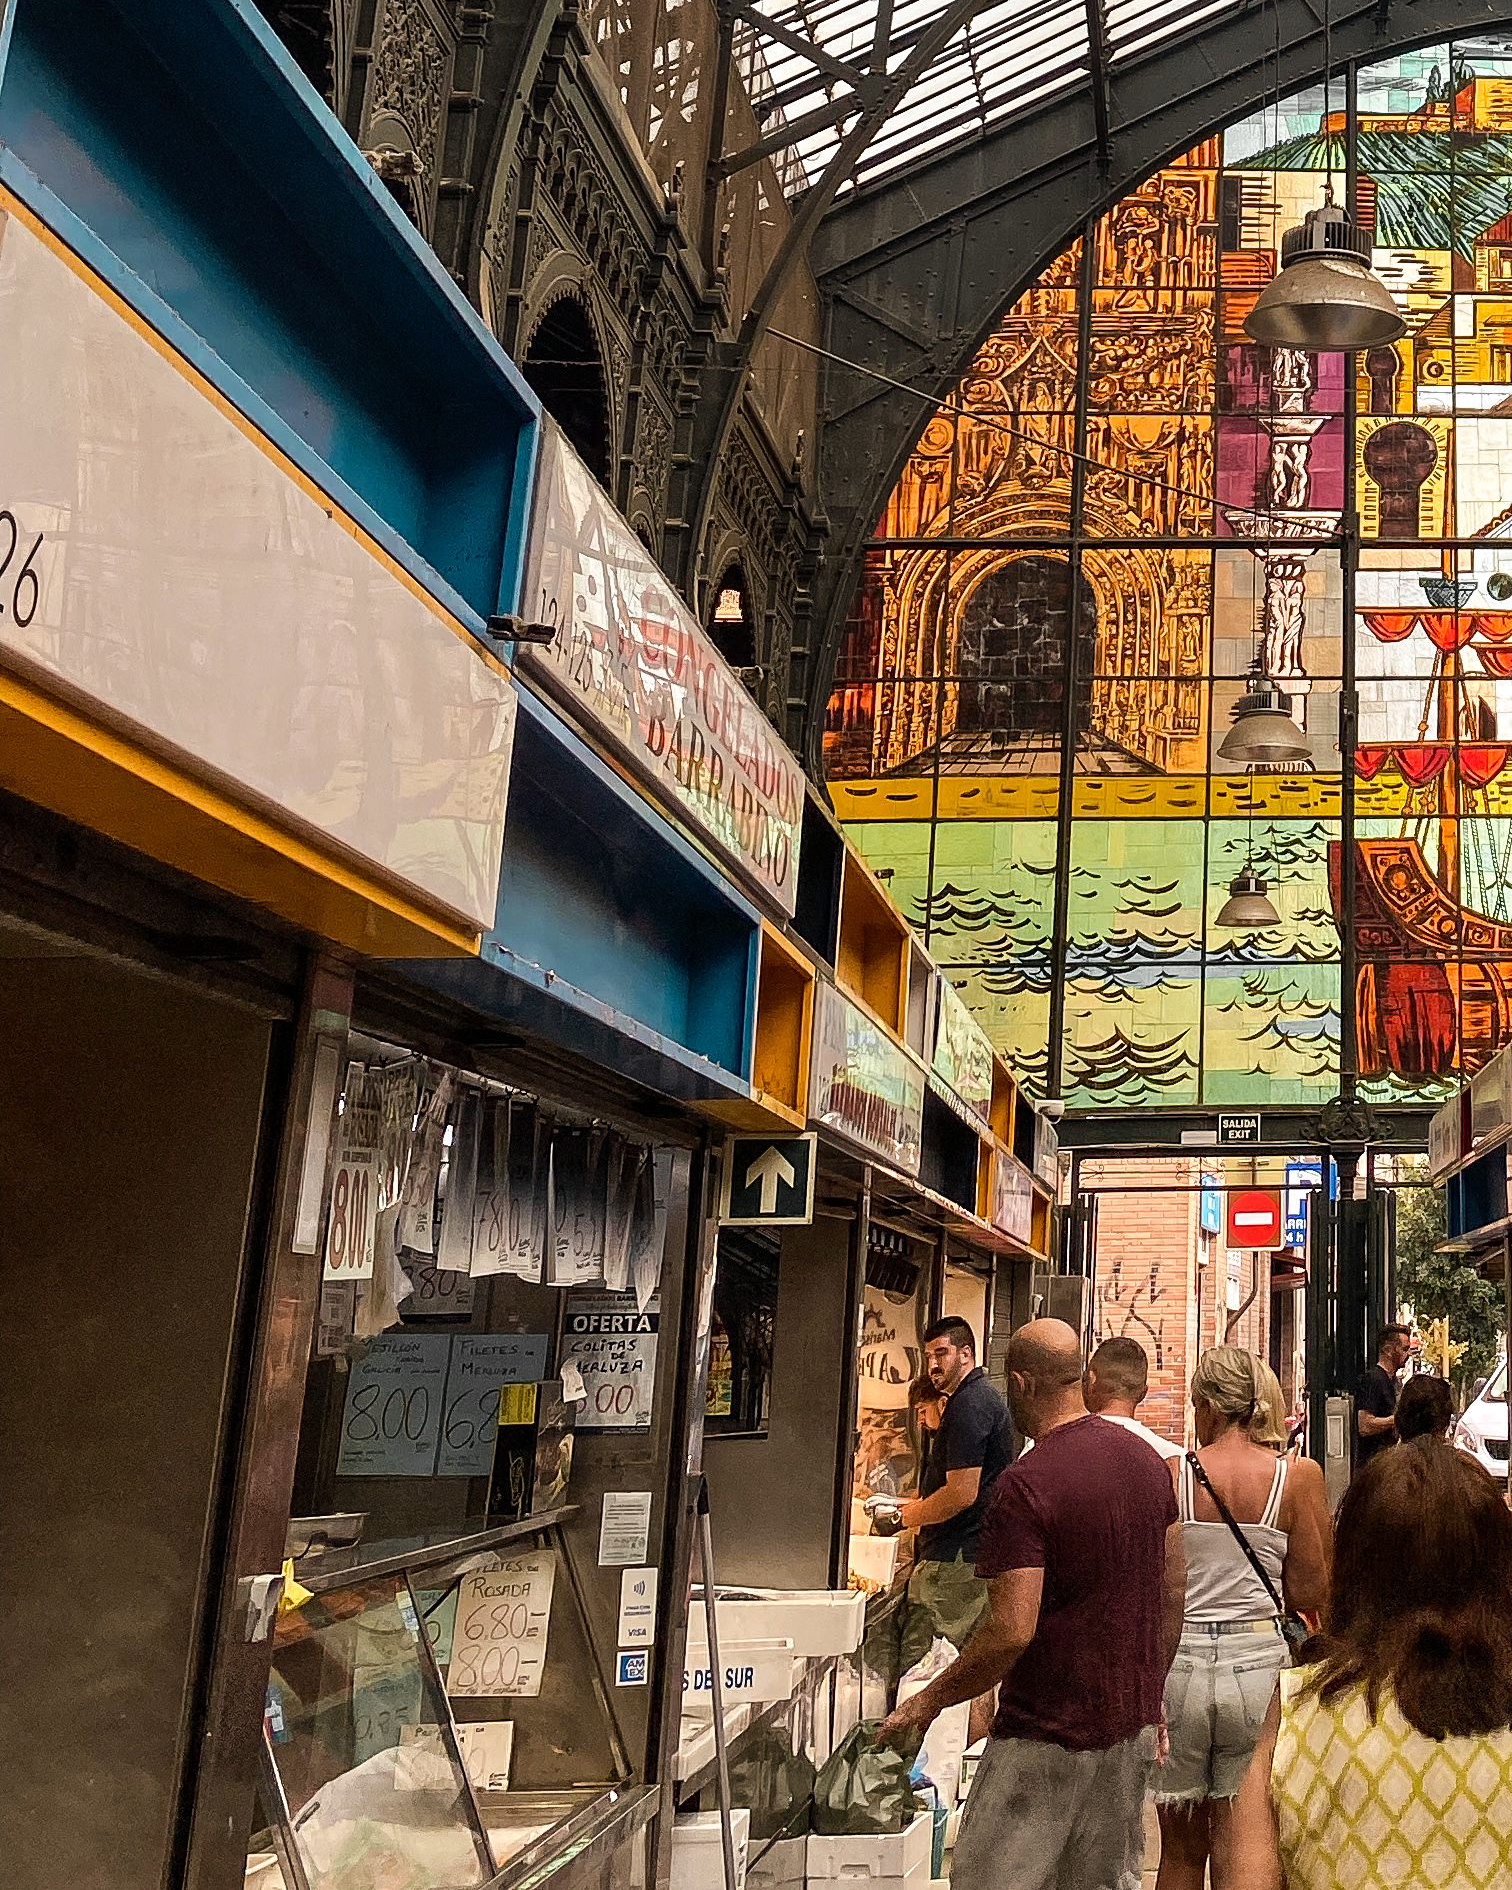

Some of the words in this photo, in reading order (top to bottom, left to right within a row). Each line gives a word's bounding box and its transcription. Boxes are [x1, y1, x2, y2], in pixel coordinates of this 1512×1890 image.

[1223, 1119, 1257, 1129] SALIDA
[1229, 1129, 1251, 1139] EXIT
[573, 1314, 652, 1332] OFERTA
[461, 1339, 519, 1356] FILETES
[571, 1337, 638, 1353] COLITAS
[467, 1576, 532, 1599] ROSADA
[694, 1668, 714, 1691] DE
[725, 1666, 754, 1689] SUR
